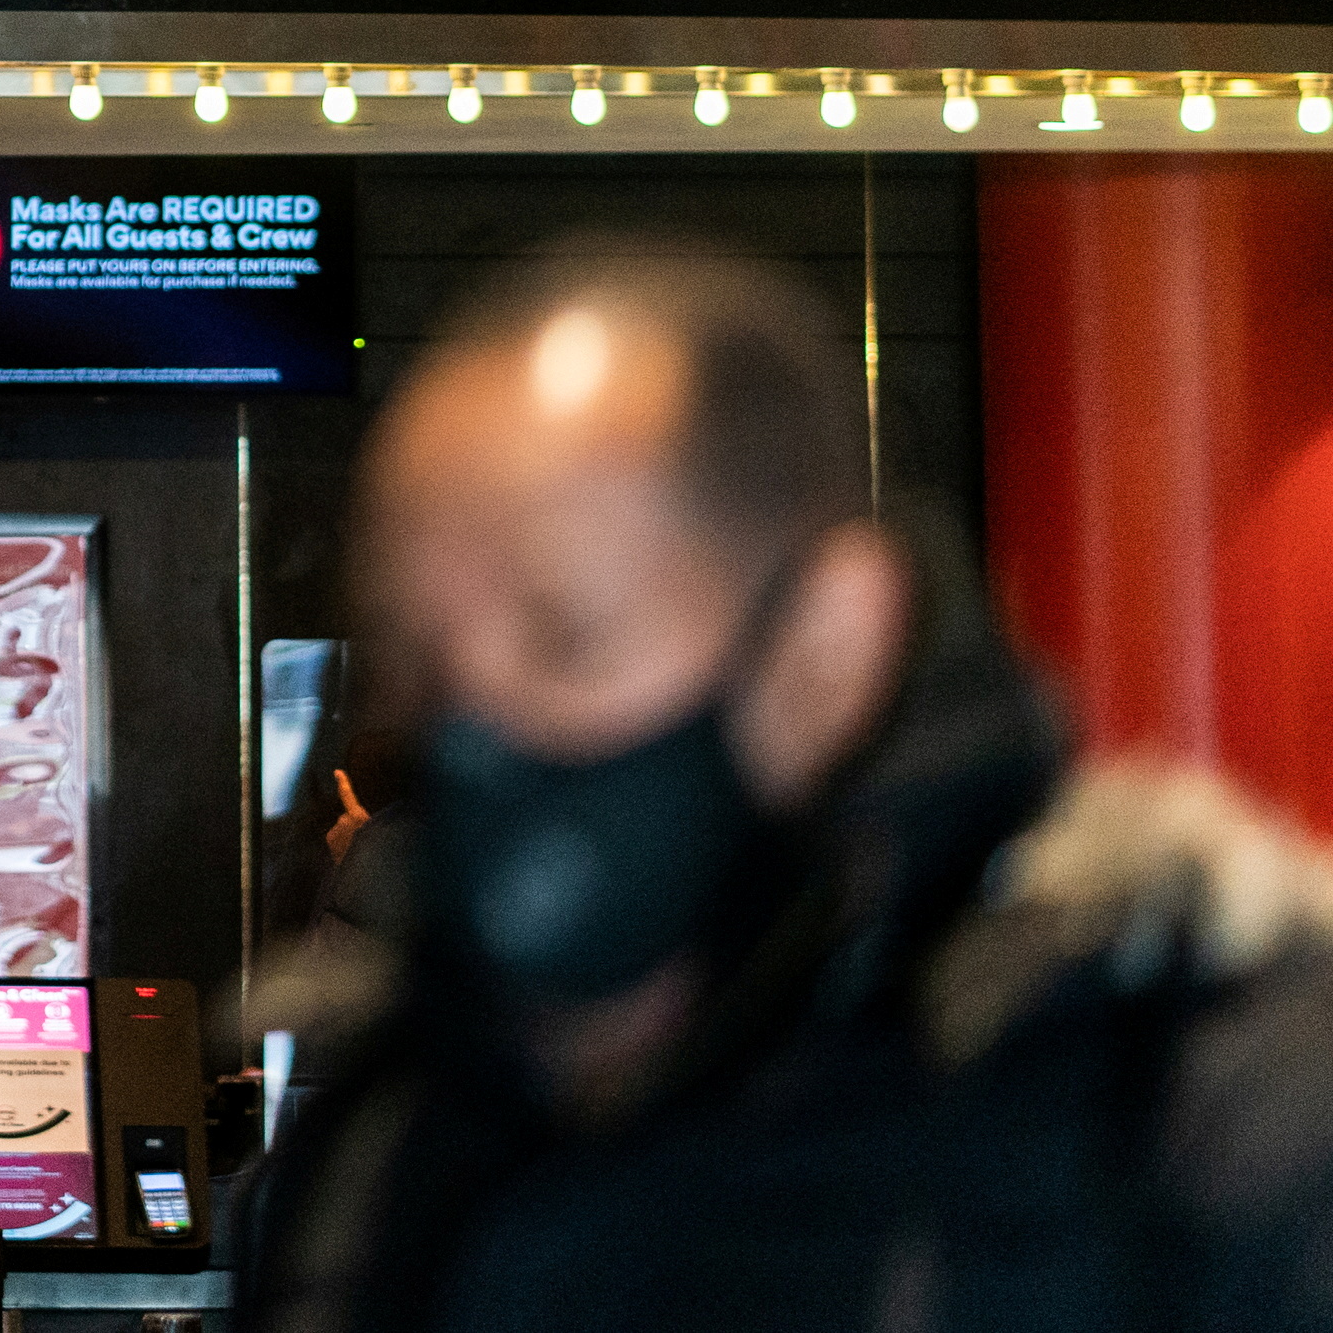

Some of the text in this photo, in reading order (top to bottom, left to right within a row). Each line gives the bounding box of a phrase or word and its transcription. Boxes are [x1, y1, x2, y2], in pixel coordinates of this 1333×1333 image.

[10, 195, 320, 224] Masks Are REQUIRED
[10, 222, 318, 250] For All Guests & Crew
[10, 258, 66, 274] PLEASE
[67, 258, 99, 274] PUT
[99, 258, 151, 274] YOURS
[151, 258, 179, 274] ON
[179, 258, 237, 274] BEFORE
[10, 274, 54, 289] Masks
[55, 276, 79, 289] are
[79, 274, 140, 289] available
[141, 274, 162, 289] for
[162, 275, 227, 292] purchase
[227, 273, 238, 289] if
